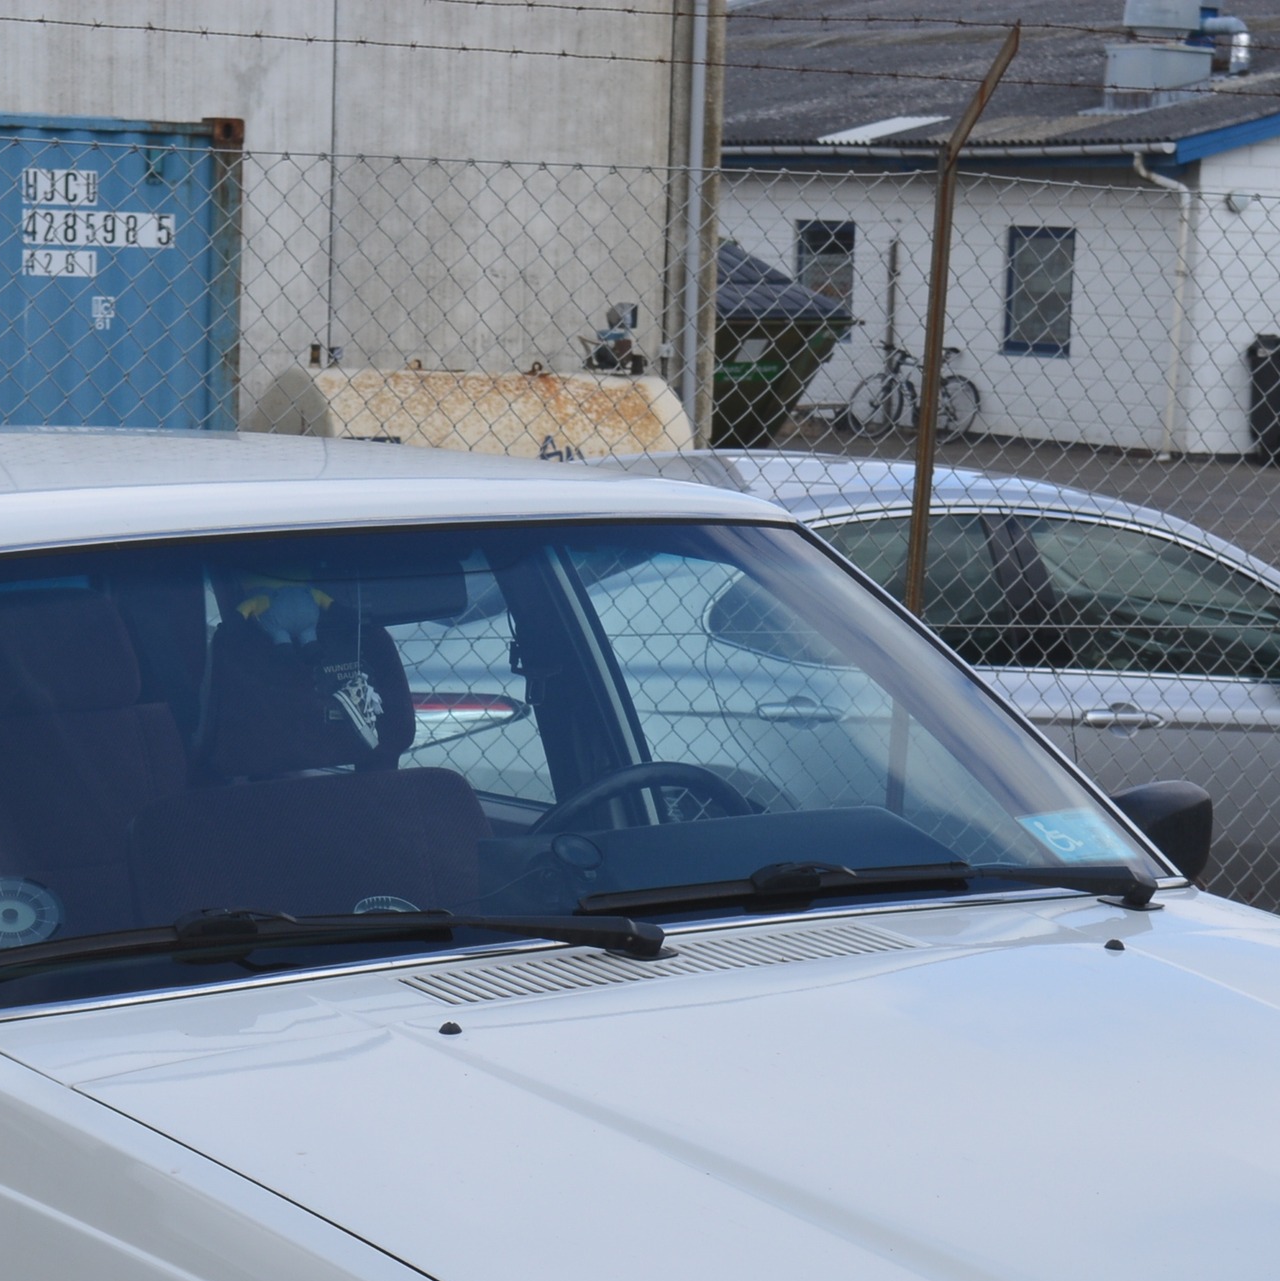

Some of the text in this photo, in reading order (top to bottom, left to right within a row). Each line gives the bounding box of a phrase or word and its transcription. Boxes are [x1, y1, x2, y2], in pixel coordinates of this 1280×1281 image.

[25, 170, 97, 203] HJCU
[24, 211, 172, 246] 428598 5
